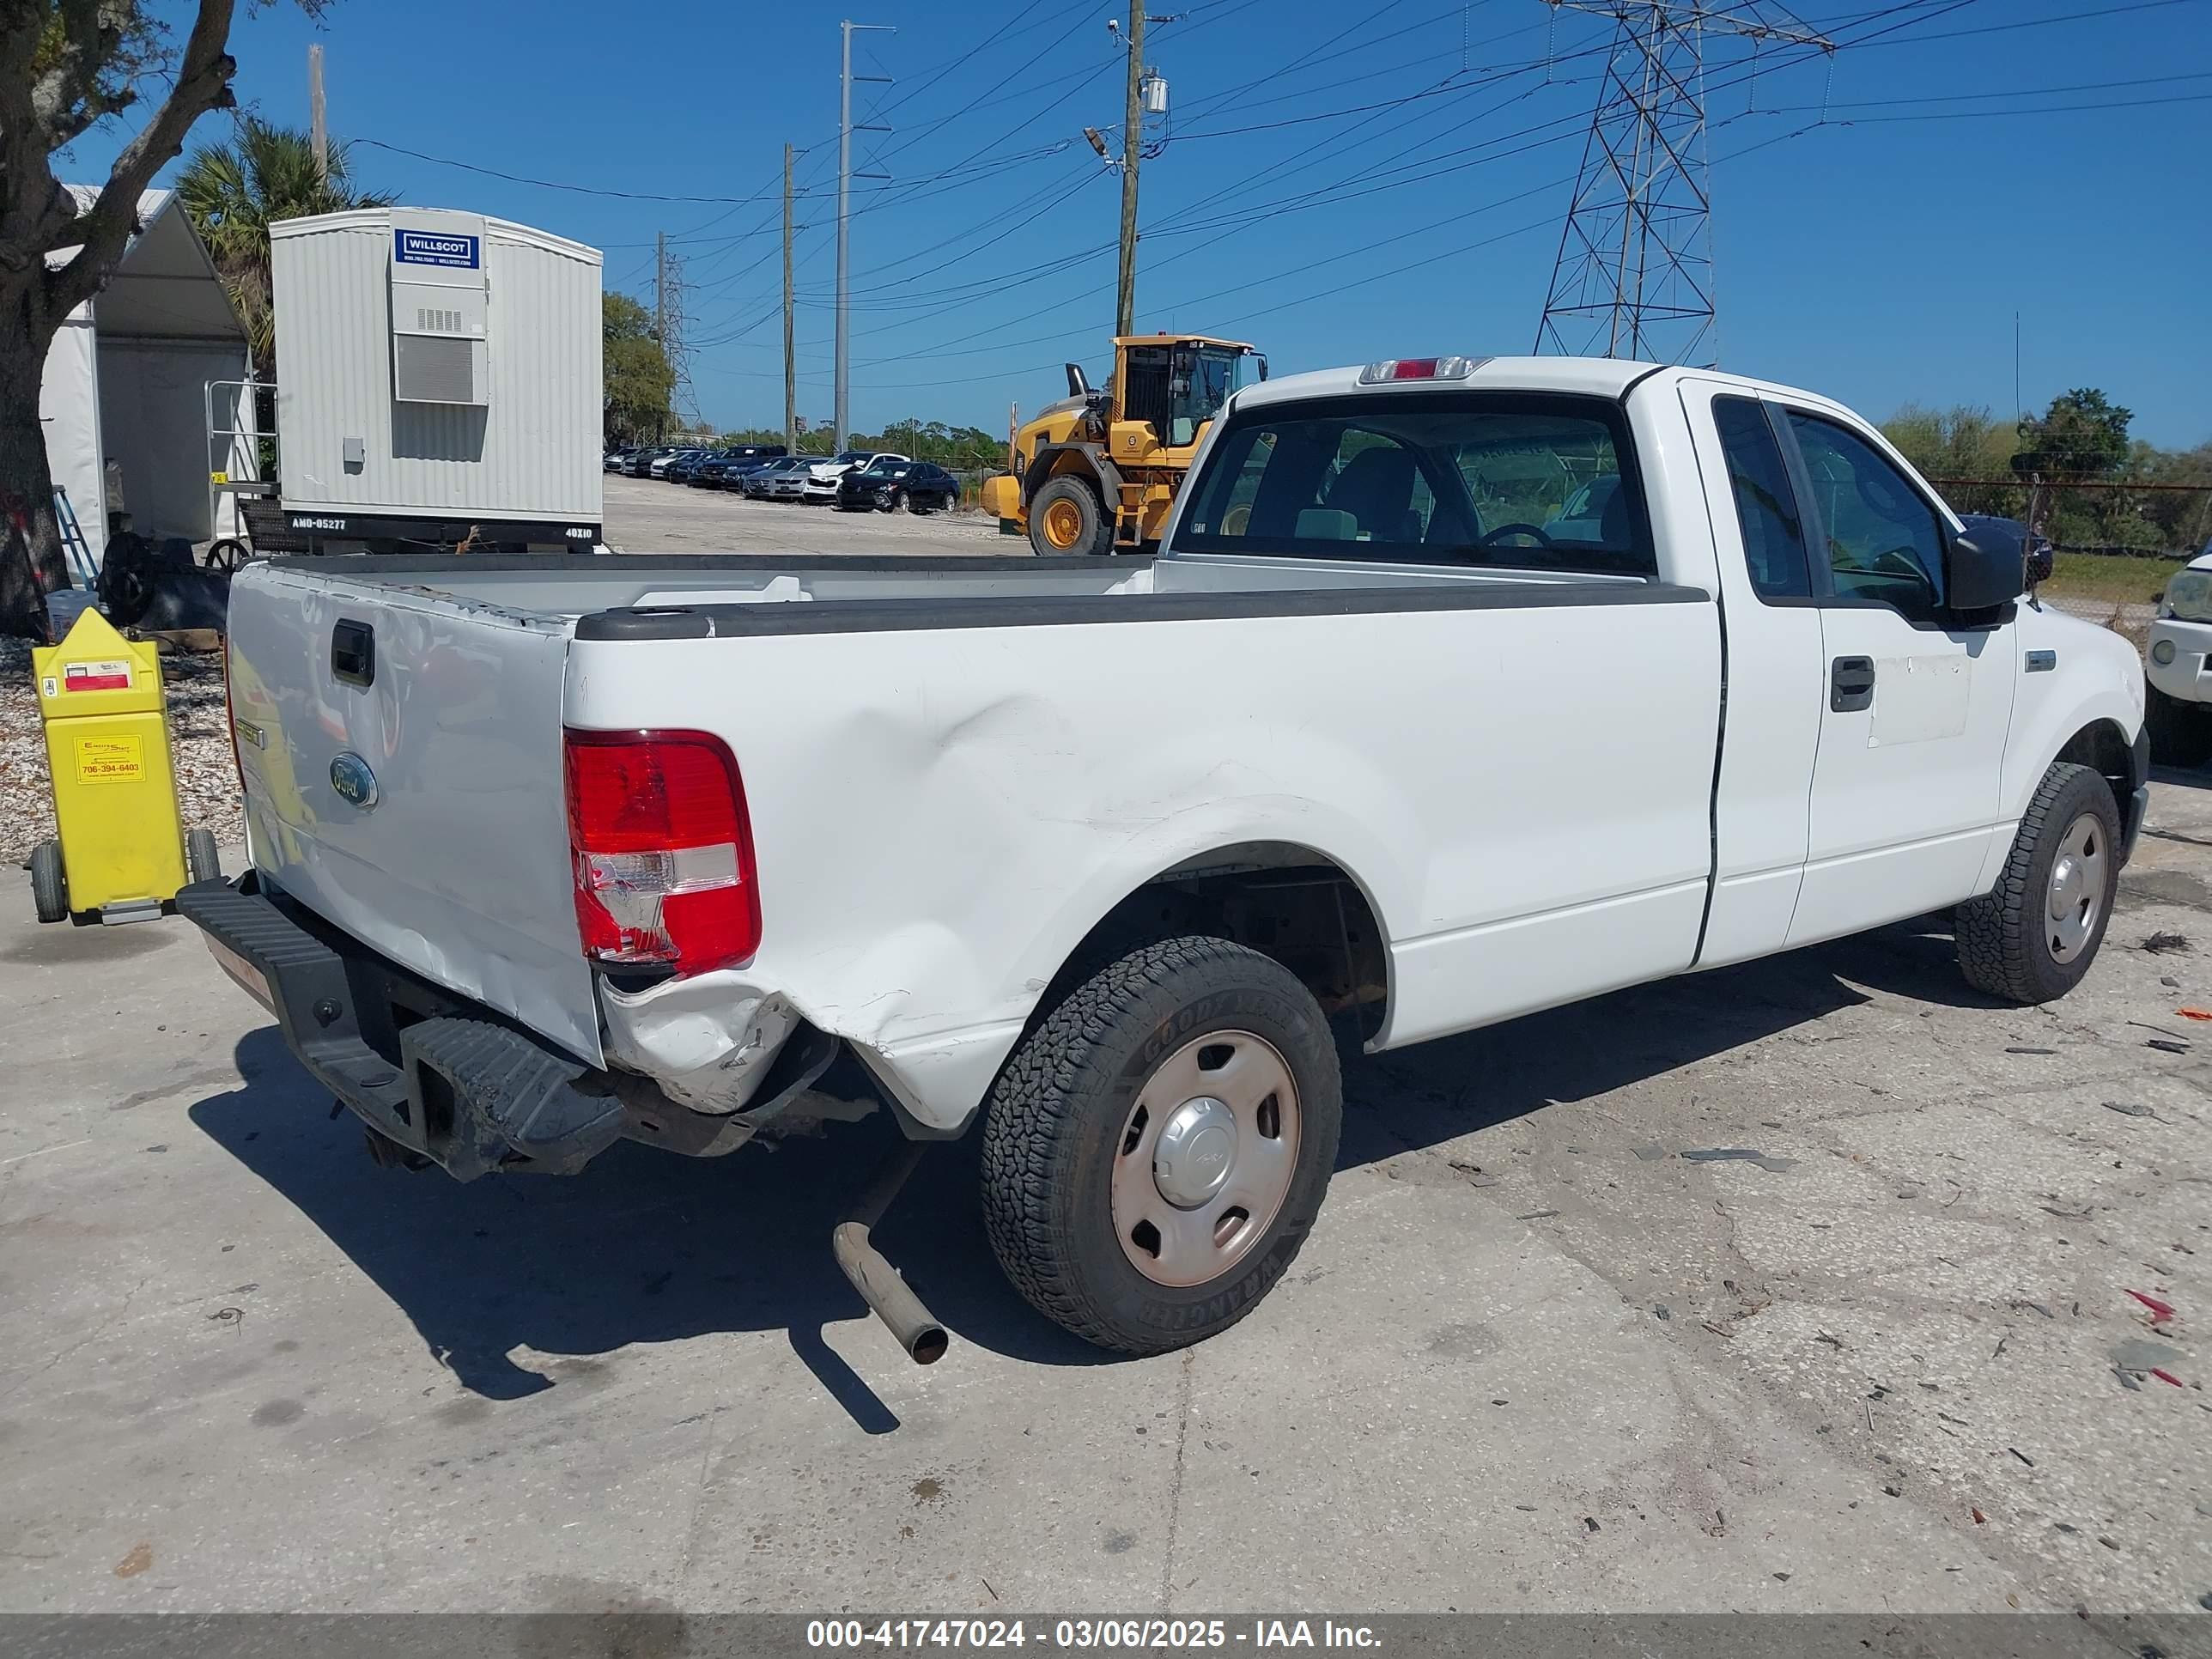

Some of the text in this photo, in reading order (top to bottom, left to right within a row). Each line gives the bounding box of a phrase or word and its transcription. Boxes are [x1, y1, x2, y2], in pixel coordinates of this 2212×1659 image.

[410, 239, 465, 252] WILLSCOT
[566, 527, 592, 538] 40X10
[82, 764, 139, 773] 706-394-6403
[334, 763, 359, 798] Ford
